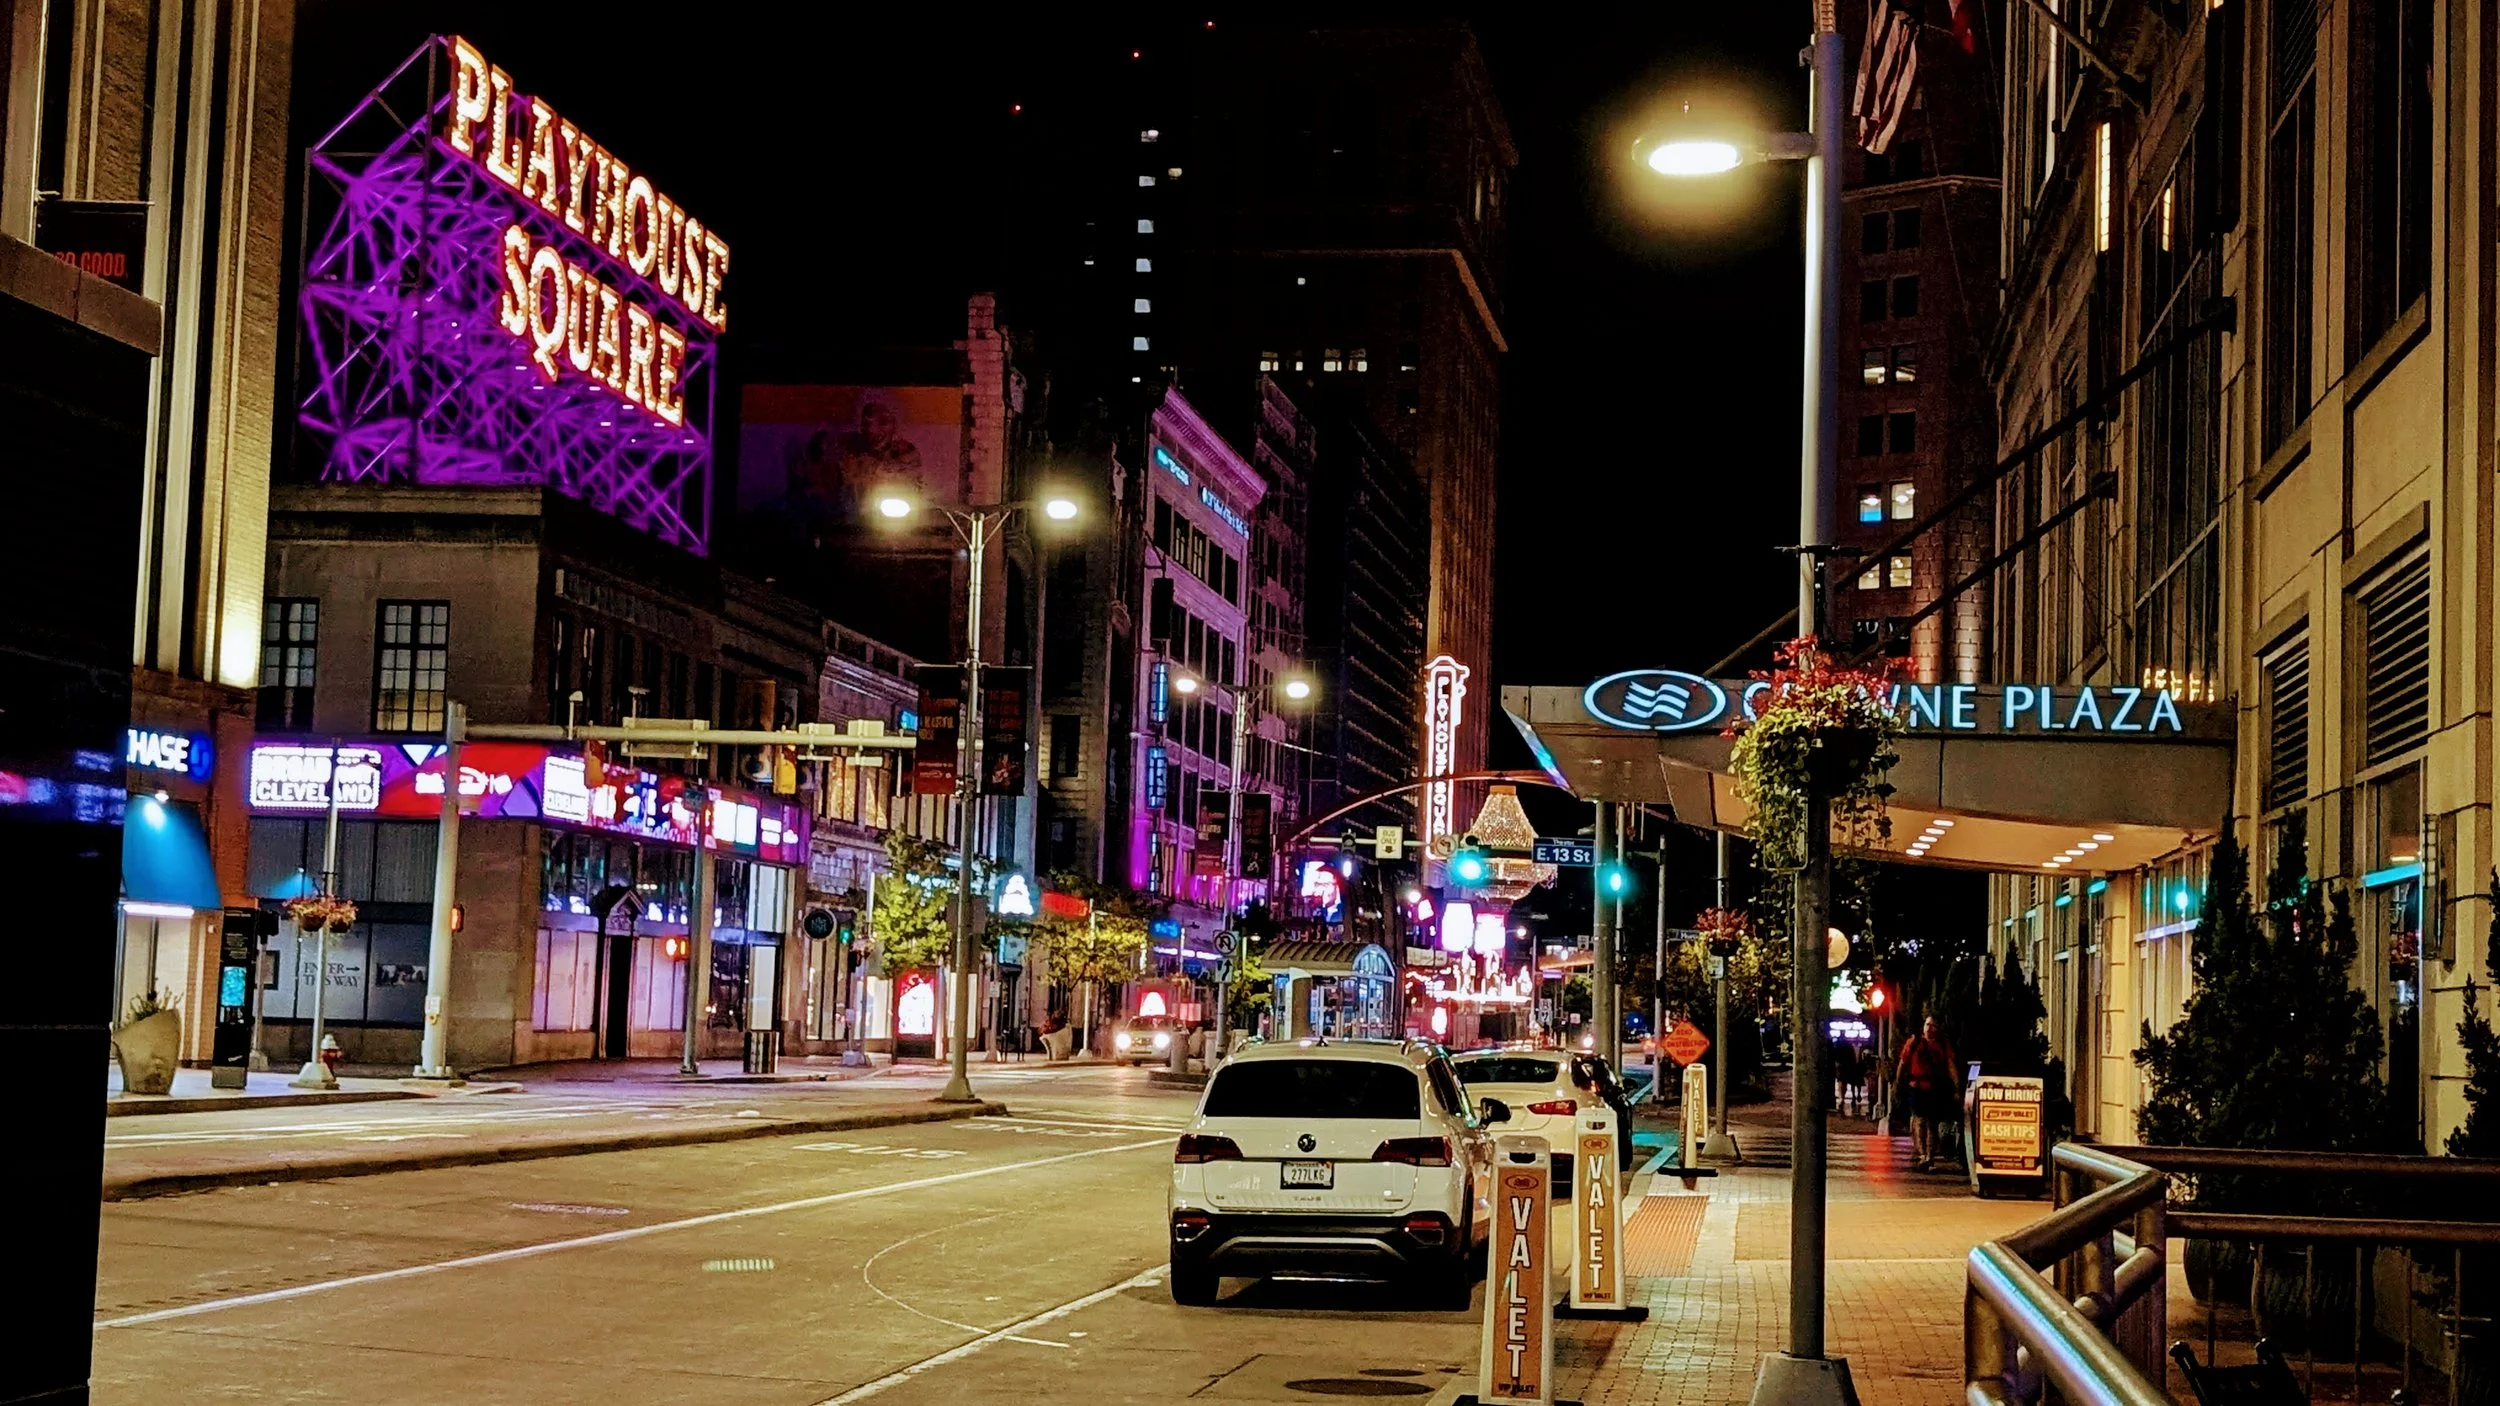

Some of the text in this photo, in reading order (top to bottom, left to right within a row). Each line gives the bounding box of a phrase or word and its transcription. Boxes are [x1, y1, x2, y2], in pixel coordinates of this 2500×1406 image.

[446, 35, 729, 332] PLAYHOUSE
[501, 224, 684, 425] SQUARE
[1435, 676, 1450, 777] PLAYHOUSE
[1742, 681, 2182, 731] CWNE PLAZA
[127, 729, 190, 773] HASE
[1536, 847, 1590, 863] E. 13 St
[304, 961, 345, 974] ENER
[1979, 1088, 2041, 1102] NOW HIRING
[1983, 1124, 2036, 1138] CASH TIPS
[1588, 1153, 1605, 1289] VALET
[1506, 1196, 1533, 1378] VALET
